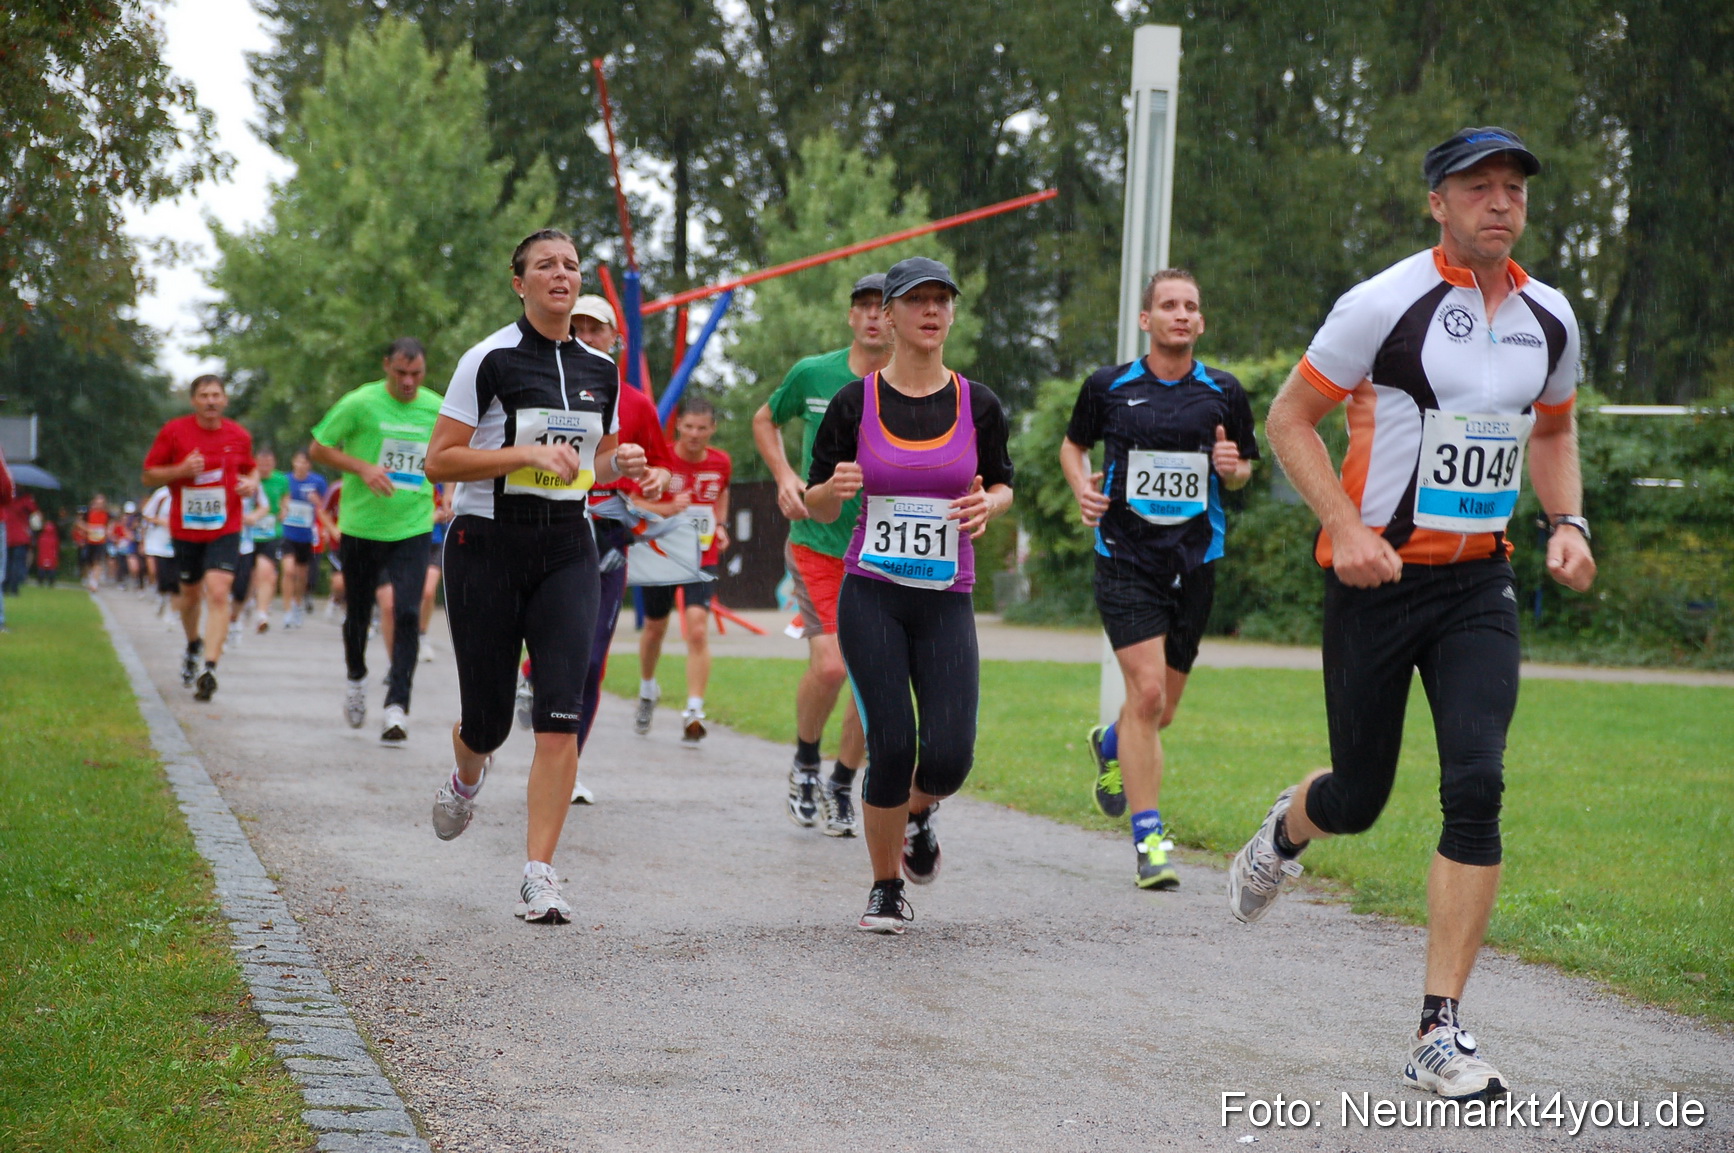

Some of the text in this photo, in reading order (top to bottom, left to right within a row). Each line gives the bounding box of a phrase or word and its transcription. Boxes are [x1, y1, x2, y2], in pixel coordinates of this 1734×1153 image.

[1433, 443, 1519, 487] 3049
[1136, 470, 1199, 498] 2438
[1149, 502, 1182, 515] Stefan
[1458, 496, 1496, 516] Klaus
[874, 520, 947, 557] 3151
[882, 559, 934, 578] Stefanie
